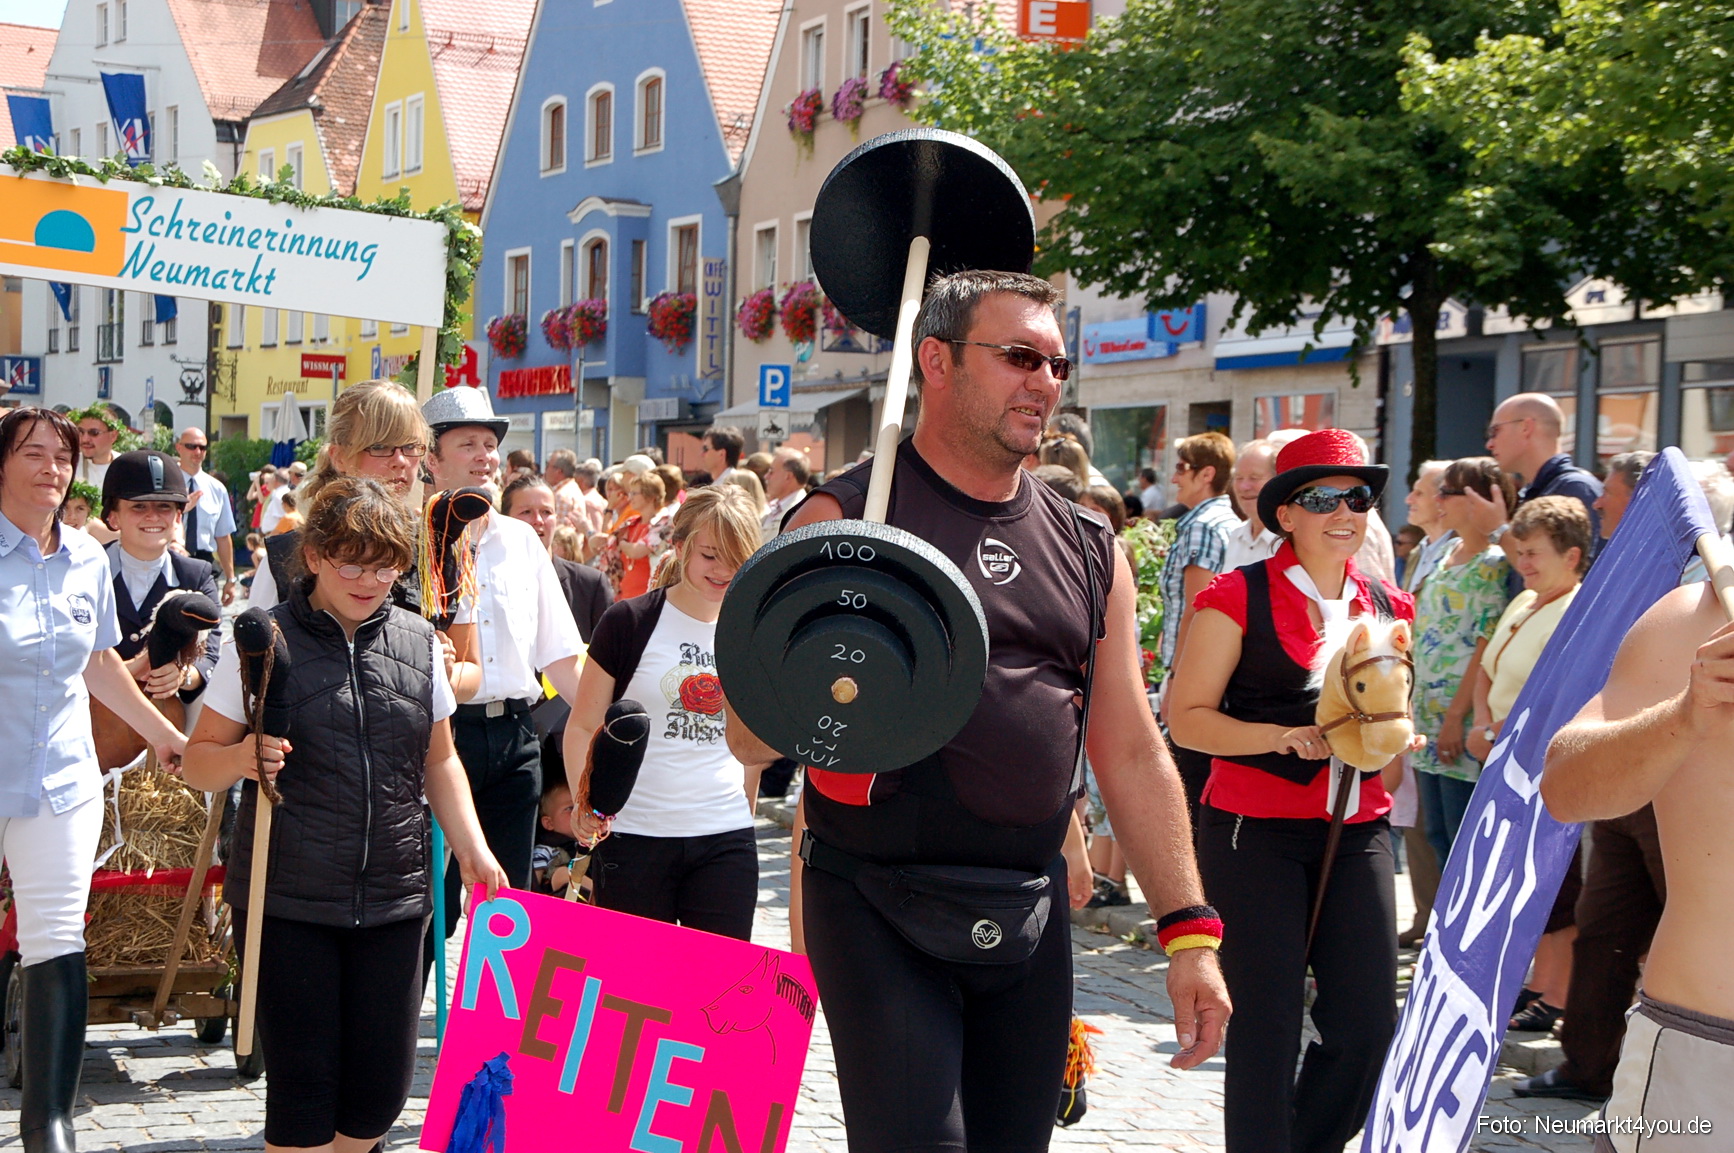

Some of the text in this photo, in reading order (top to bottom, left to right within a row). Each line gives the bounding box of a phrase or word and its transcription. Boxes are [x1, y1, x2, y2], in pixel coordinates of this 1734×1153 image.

[1029, 2, 1058, 35] E
[120, 196, 379, 281] Schreinerinnung
[117, 240, 276, 295] Neumarkt
[303, 360, 345, 373] WISSMAH
[266, 376, 309, 395] Restaurant
[497, 365, 574, 398] APOTHEKE
[765, 368, 785, 403] P
[819, 541, 876, 562] 100
[836, 589, 867, 609] 50
[830, 643, 866, 663] 20
[817, 715, 848, 737] 20
[461, 897, 785, 1153] REITEN
